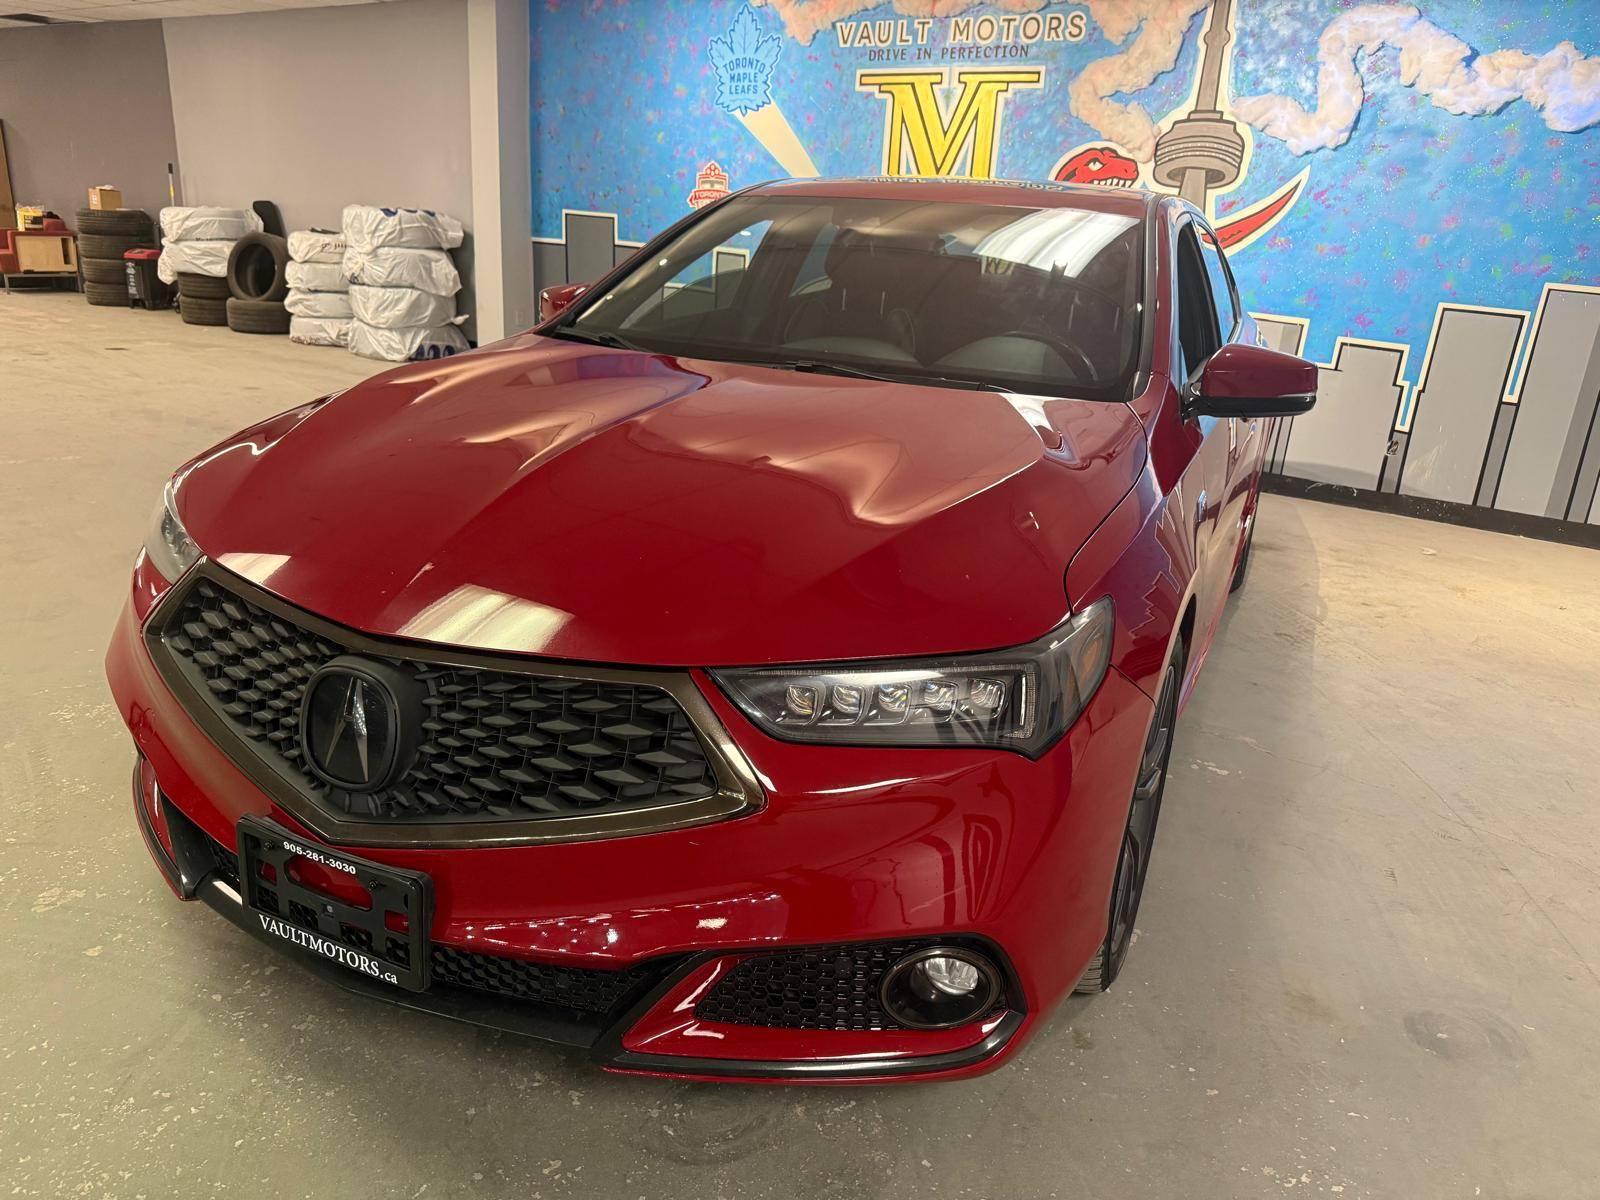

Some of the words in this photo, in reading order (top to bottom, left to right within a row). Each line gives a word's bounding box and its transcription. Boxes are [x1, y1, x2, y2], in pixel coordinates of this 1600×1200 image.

[839, 19, 932, 46] VAULT
[951, 12, 1086, 43] MOTORS
[868, 49, 908, 62] DRIVE
[917, 47, 931, 60] IN
[941, 45, 1029, 60] PERFECTION
[723, 57, 766, 74] TORONTO
[729, 72, 759, 83] MAPLE
[729, 84, 758, 95] LEAFS
[283, 841, 356, 875] 905-281-3030
[258, 914, 398, 984] VAULTMOTORS.ca
